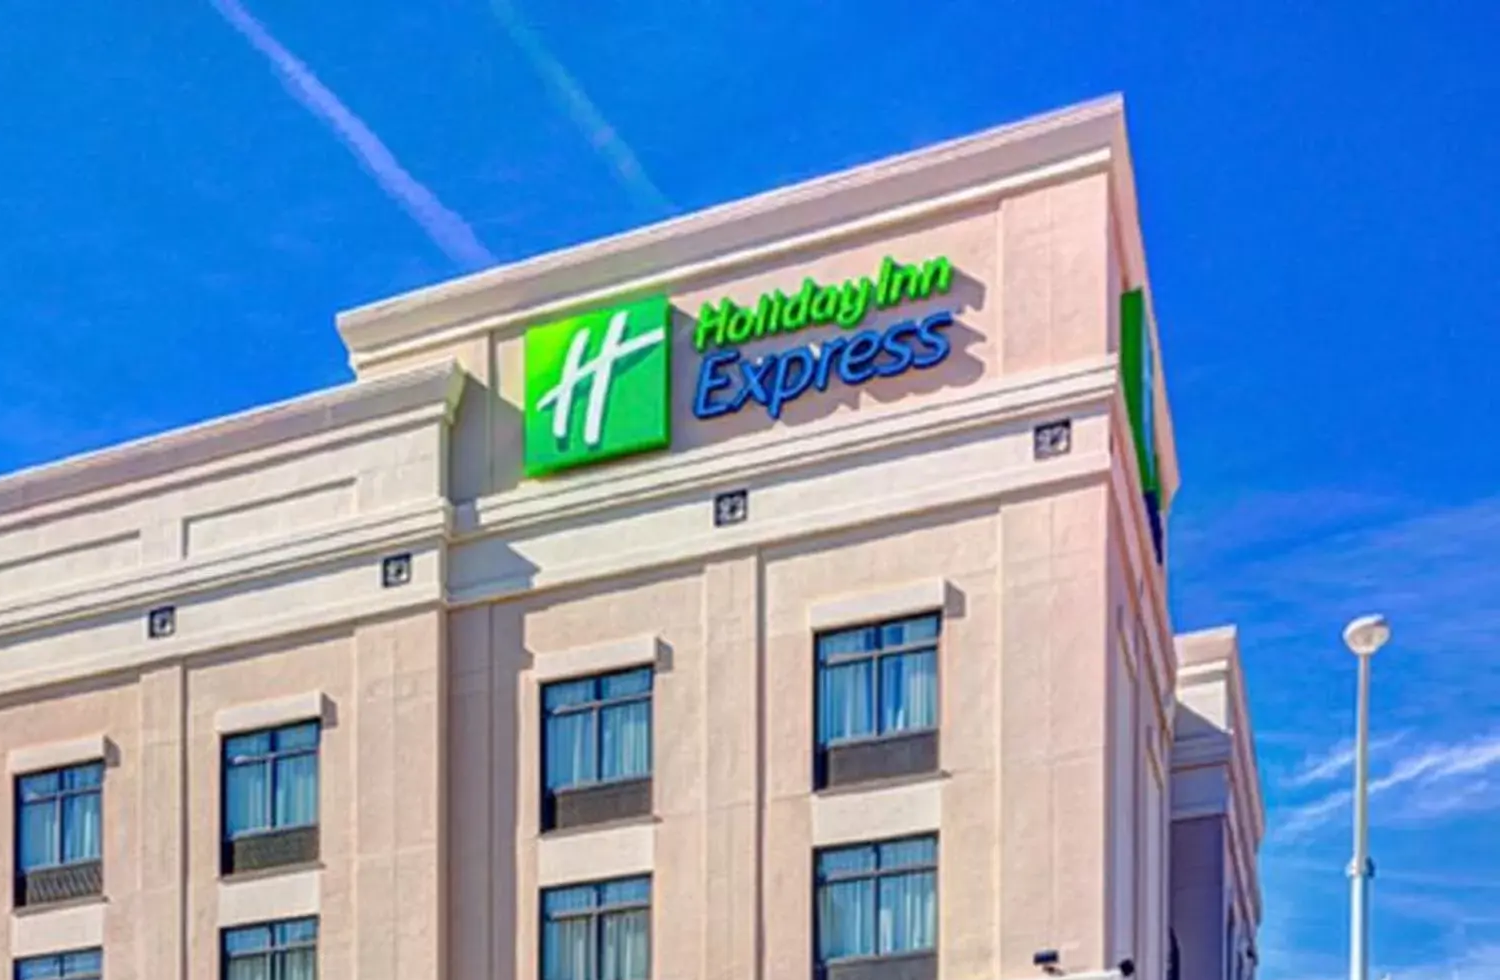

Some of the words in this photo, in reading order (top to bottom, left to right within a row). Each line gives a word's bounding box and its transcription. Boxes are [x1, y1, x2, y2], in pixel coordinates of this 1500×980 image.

[694, 278, 872, 351] Holiday
[876, 256, 952, 309] Inn
[537, 311, 664, 444] H
[694, 311, 953, 419] Express
